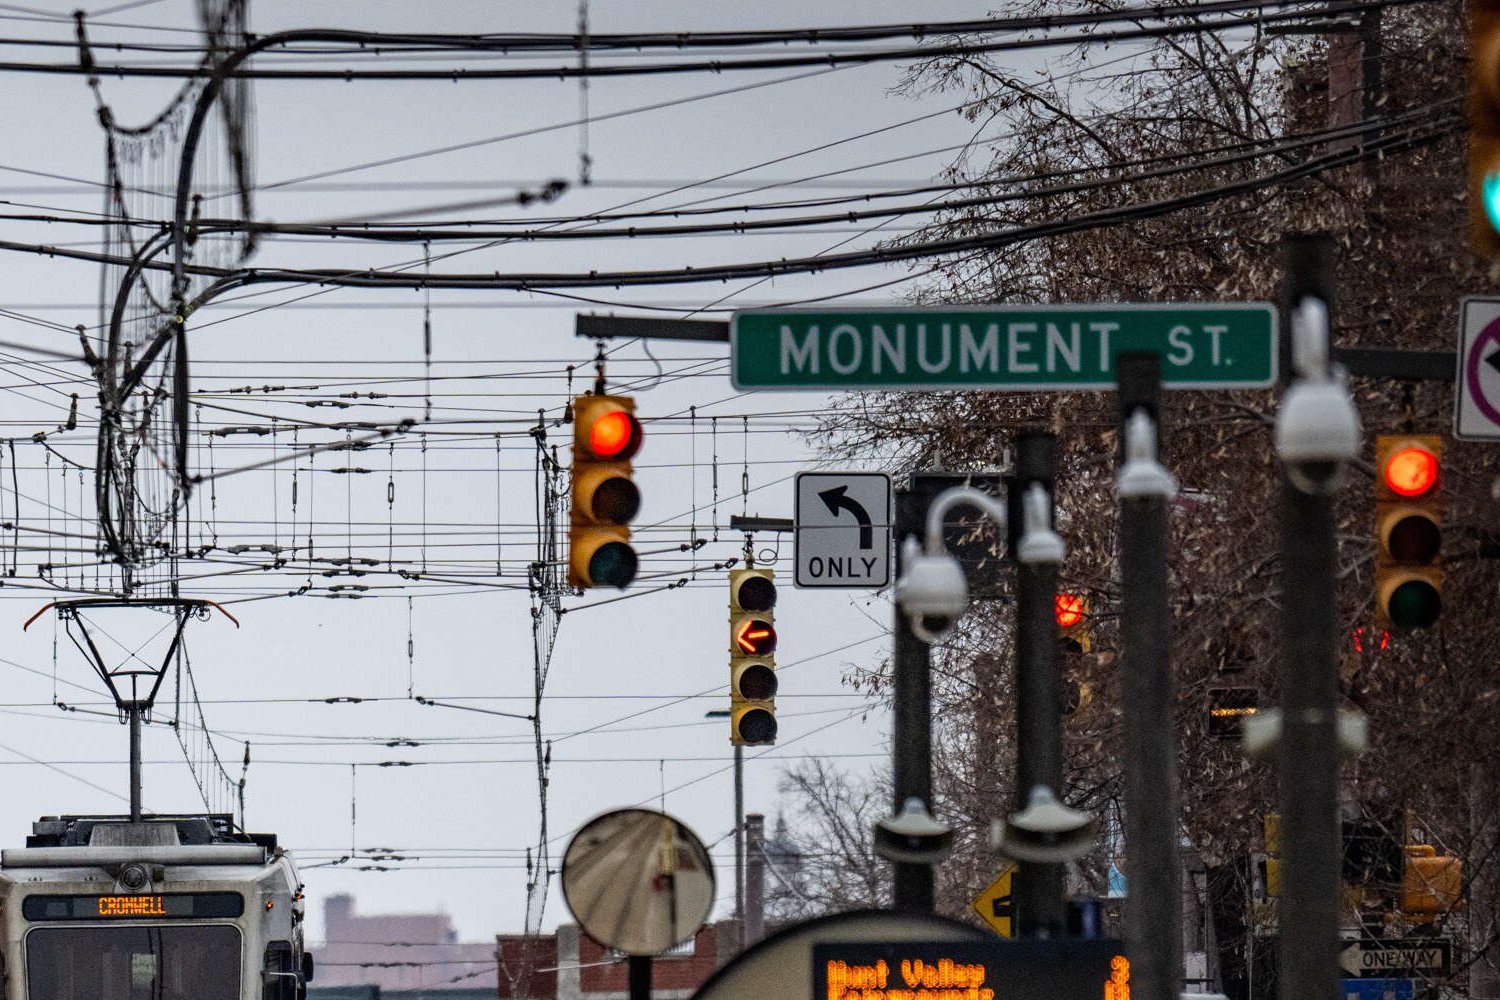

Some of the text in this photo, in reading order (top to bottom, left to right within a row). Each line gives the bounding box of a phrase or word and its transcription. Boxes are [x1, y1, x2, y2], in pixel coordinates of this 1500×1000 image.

[779, 322, 1233, 375] MONUMENT ST.
[808, 556, 878, 578] ONLY
[99, 896, 166, 915] CROMWELL
[1362, 949, 1437, 967] ONE WAY
[901, 958, 985, 988] Valley
